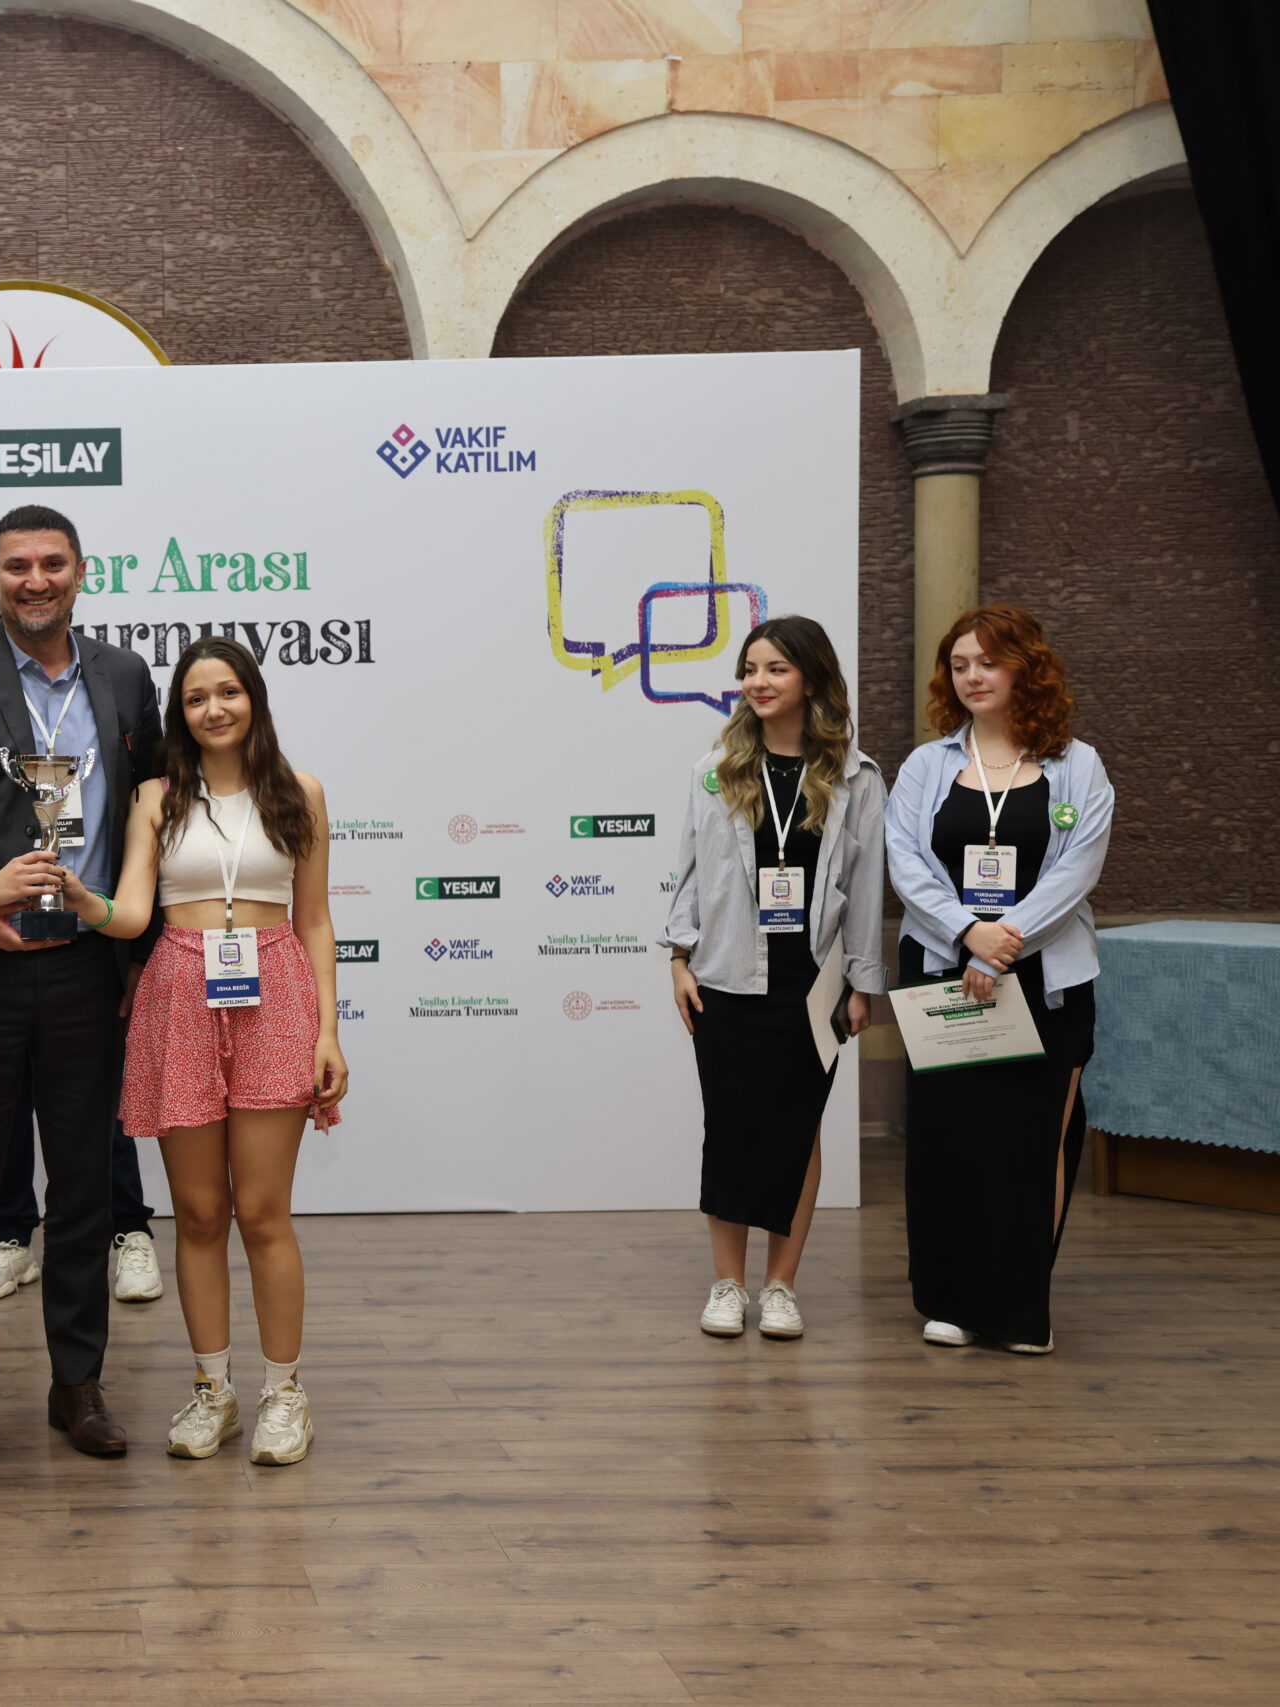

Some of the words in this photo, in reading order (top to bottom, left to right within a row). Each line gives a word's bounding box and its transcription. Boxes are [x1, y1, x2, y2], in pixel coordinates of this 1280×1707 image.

[435, 426, 506, 448] VAKIF
[436, 451, 536, 473] KATILIM
[148, 536, 311, 593] Arası
[571, 875, 602, 885] VAKIF
[571, 886, 615, 896] KATILIM
[449, 939, 481, 949] VAKIF
[538, 944, 591, 955] Münazara
[592, 943, 648, 954] Turnuvası
[449, 950, 493, 960] KATILIM
[409, 1006, 462, 1017] Münazara
[463, 1005, 519, 1016] Turnuvası
